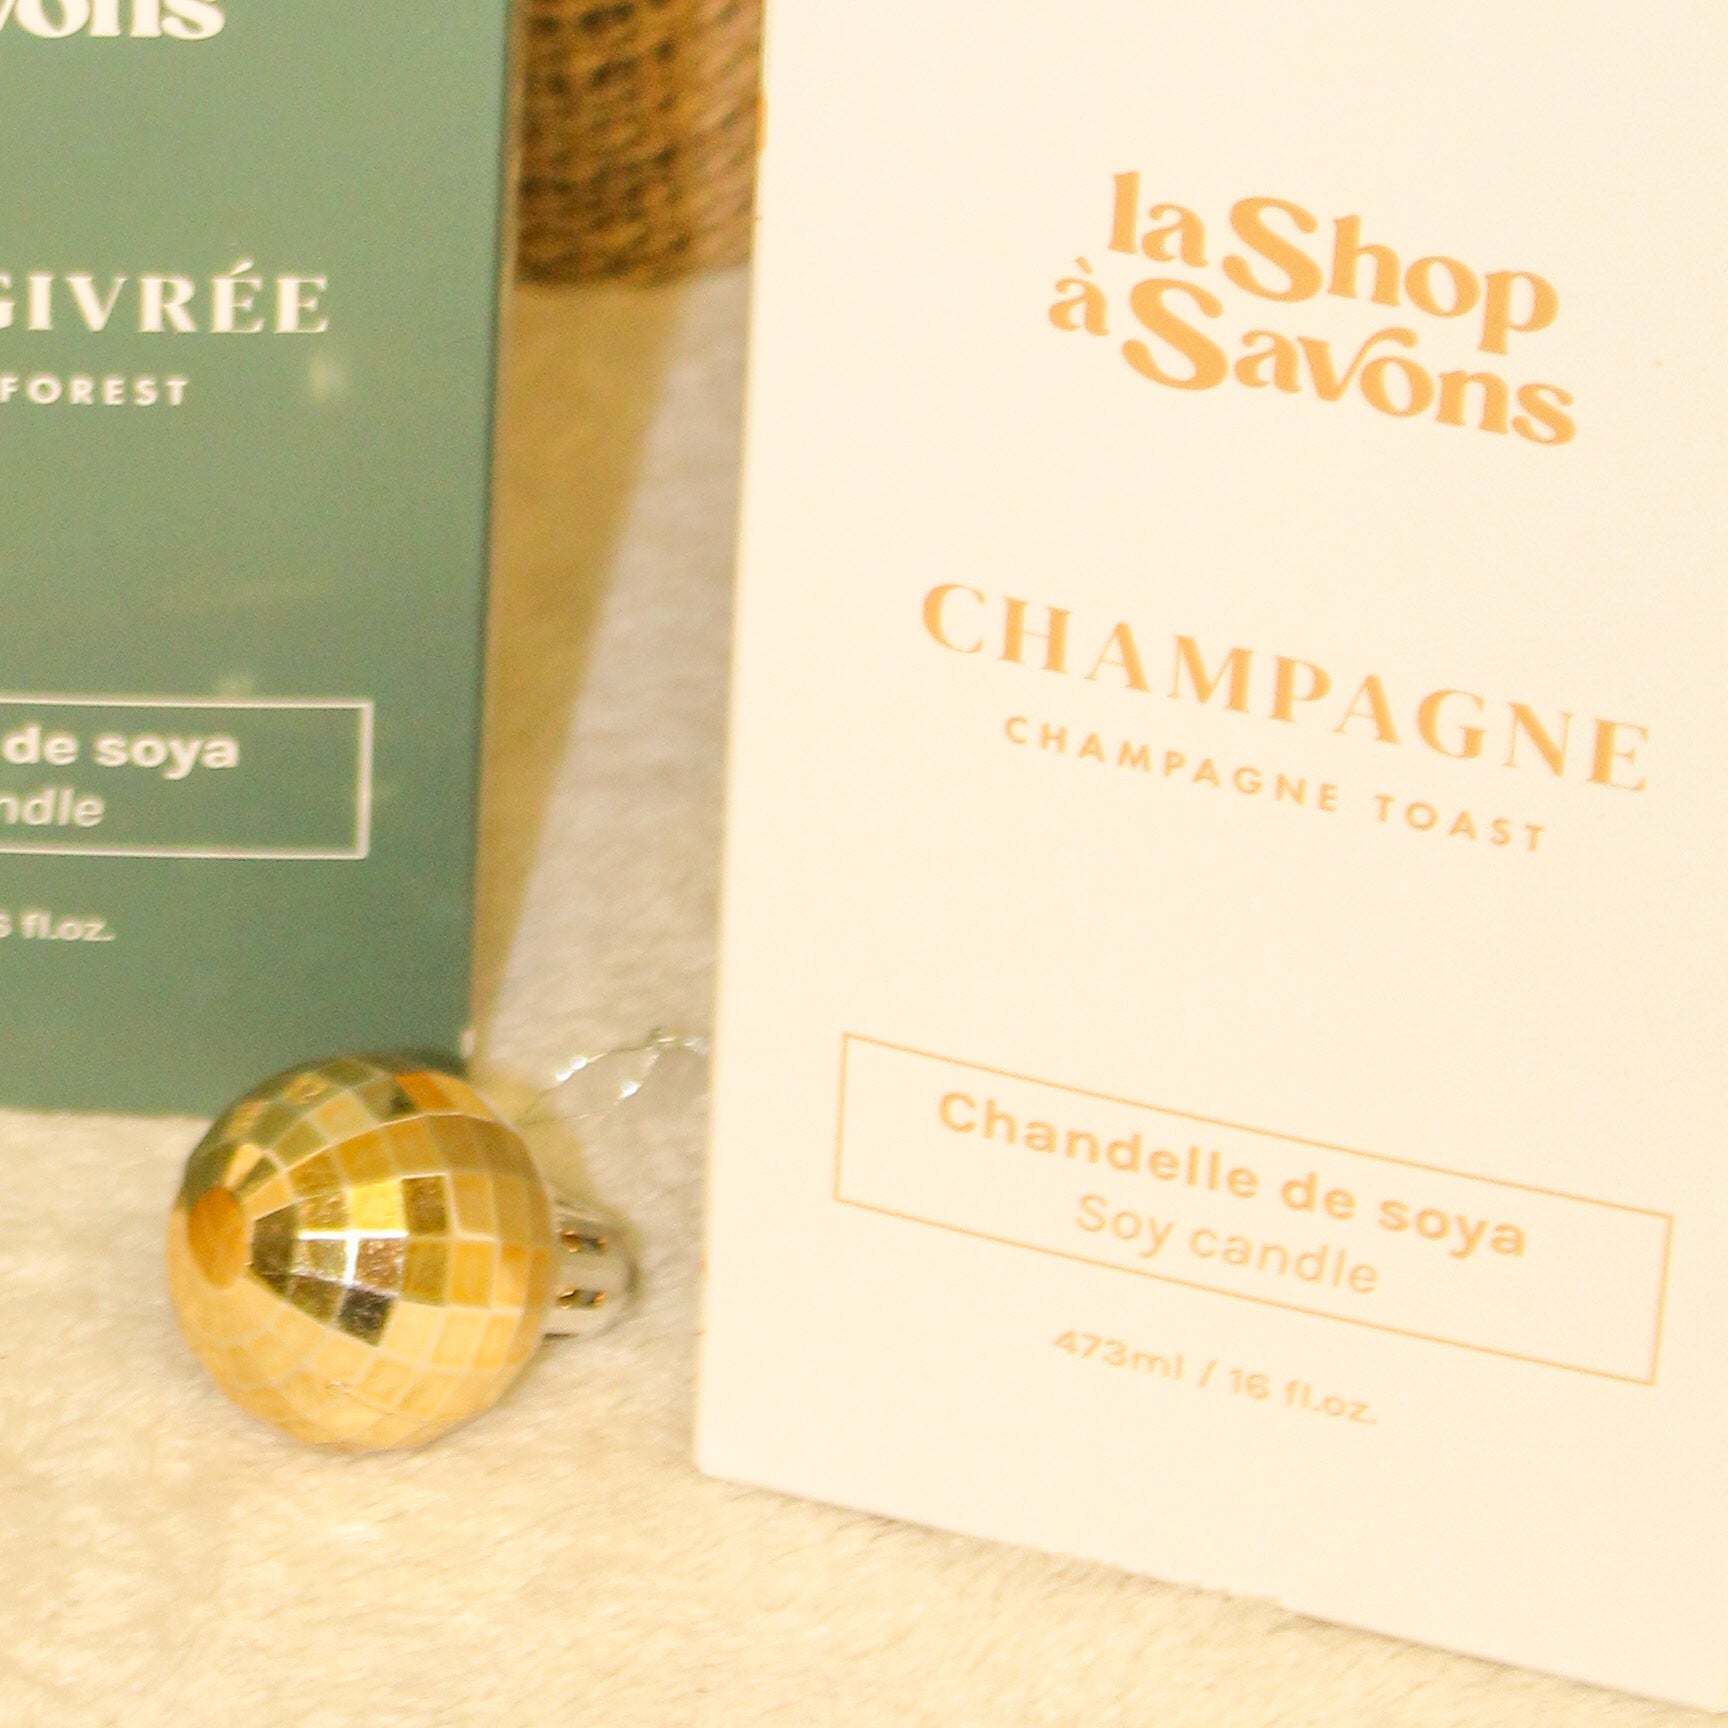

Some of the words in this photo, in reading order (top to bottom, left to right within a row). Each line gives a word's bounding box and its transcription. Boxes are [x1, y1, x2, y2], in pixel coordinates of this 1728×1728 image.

[1108, 171, 1208, 267] la
[1223, 197, 1559, 355] Shop
[1047, 257, 1109, 337] à
[1122, 277, 1578, 446] Savons
[3, 725, 80, 765] de
[94, 733, 239, 780] soya
[921, 583, 1650, 794] CHAMPAGNE
[1005, 715, 1340, 812] CHAMPAGNE
[1374, 794, 1547, 853] TOAST
[937, 1090, 1261, 1198] Chandelle
[1281, 1170, 1359, 1220] de
[1378, 1195, 1529, 1261] soya
[1074, 1192, 1176, 1258] Soy
[1190, 1225, 1380, 1296] candle
[1054, 1330, 1184, 1382] 473ml
[1228, 1368, 1271, 1401] 16
[1283, 1379, 1379, 1426] fl.oz.
